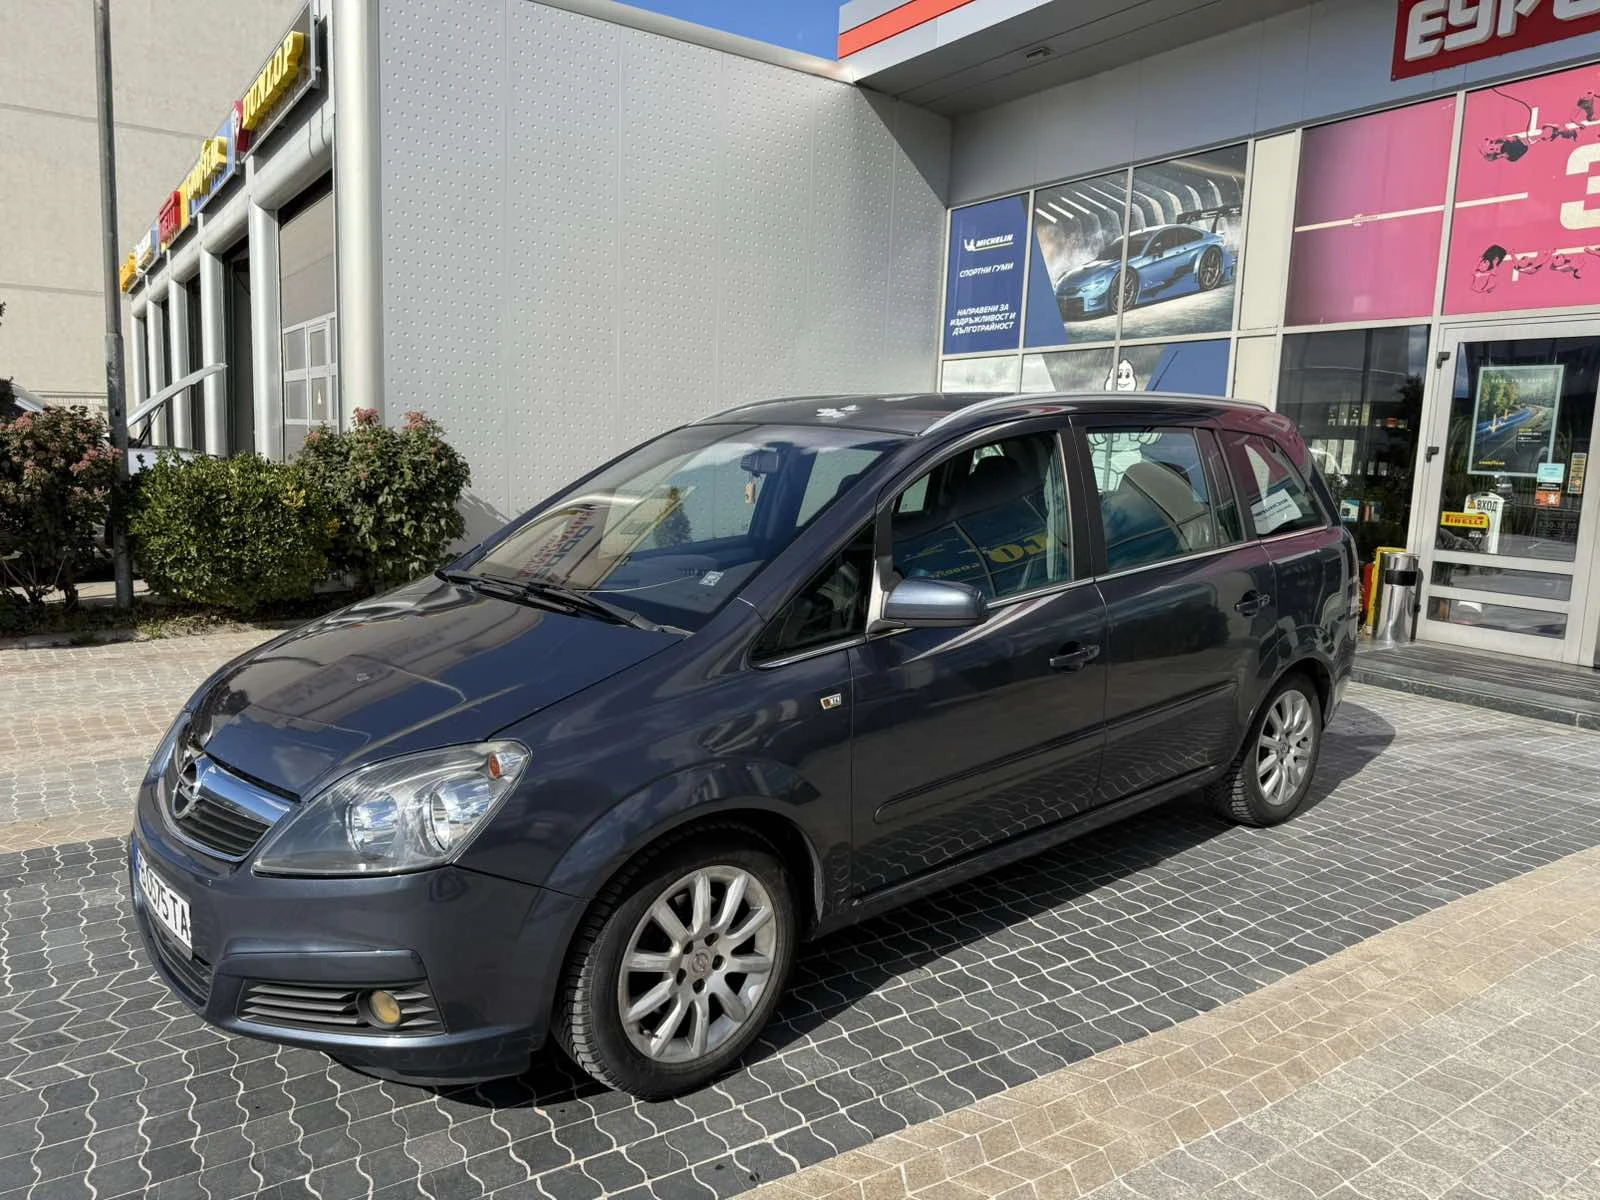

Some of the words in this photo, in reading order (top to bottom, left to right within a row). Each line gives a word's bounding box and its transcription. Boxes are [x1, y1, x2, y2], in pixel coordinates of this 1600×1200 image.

[242, 30, 304, 129] DUNLOP
[976, 234, 1014, 247] MICHELIN
[960, 265, 992, 278] СПОРТНИ
[992, 262, 1014, 273] ГУМИ
[957, 305, 999, 316] НАПРАВЕНИ
[999, 303, 1009, 312] ЗА
[950, 312, 1009, 326] ИЗДРЪЖЛИВОСТ
[1009, 312, 1016, 320] И
[952, 321, 1014, 336] ДЪЛГОТРАЙНОСТ
[1477, 500, 1498, 512] ВХОД
[1445, 514, 1485, 526] PIRELLI
